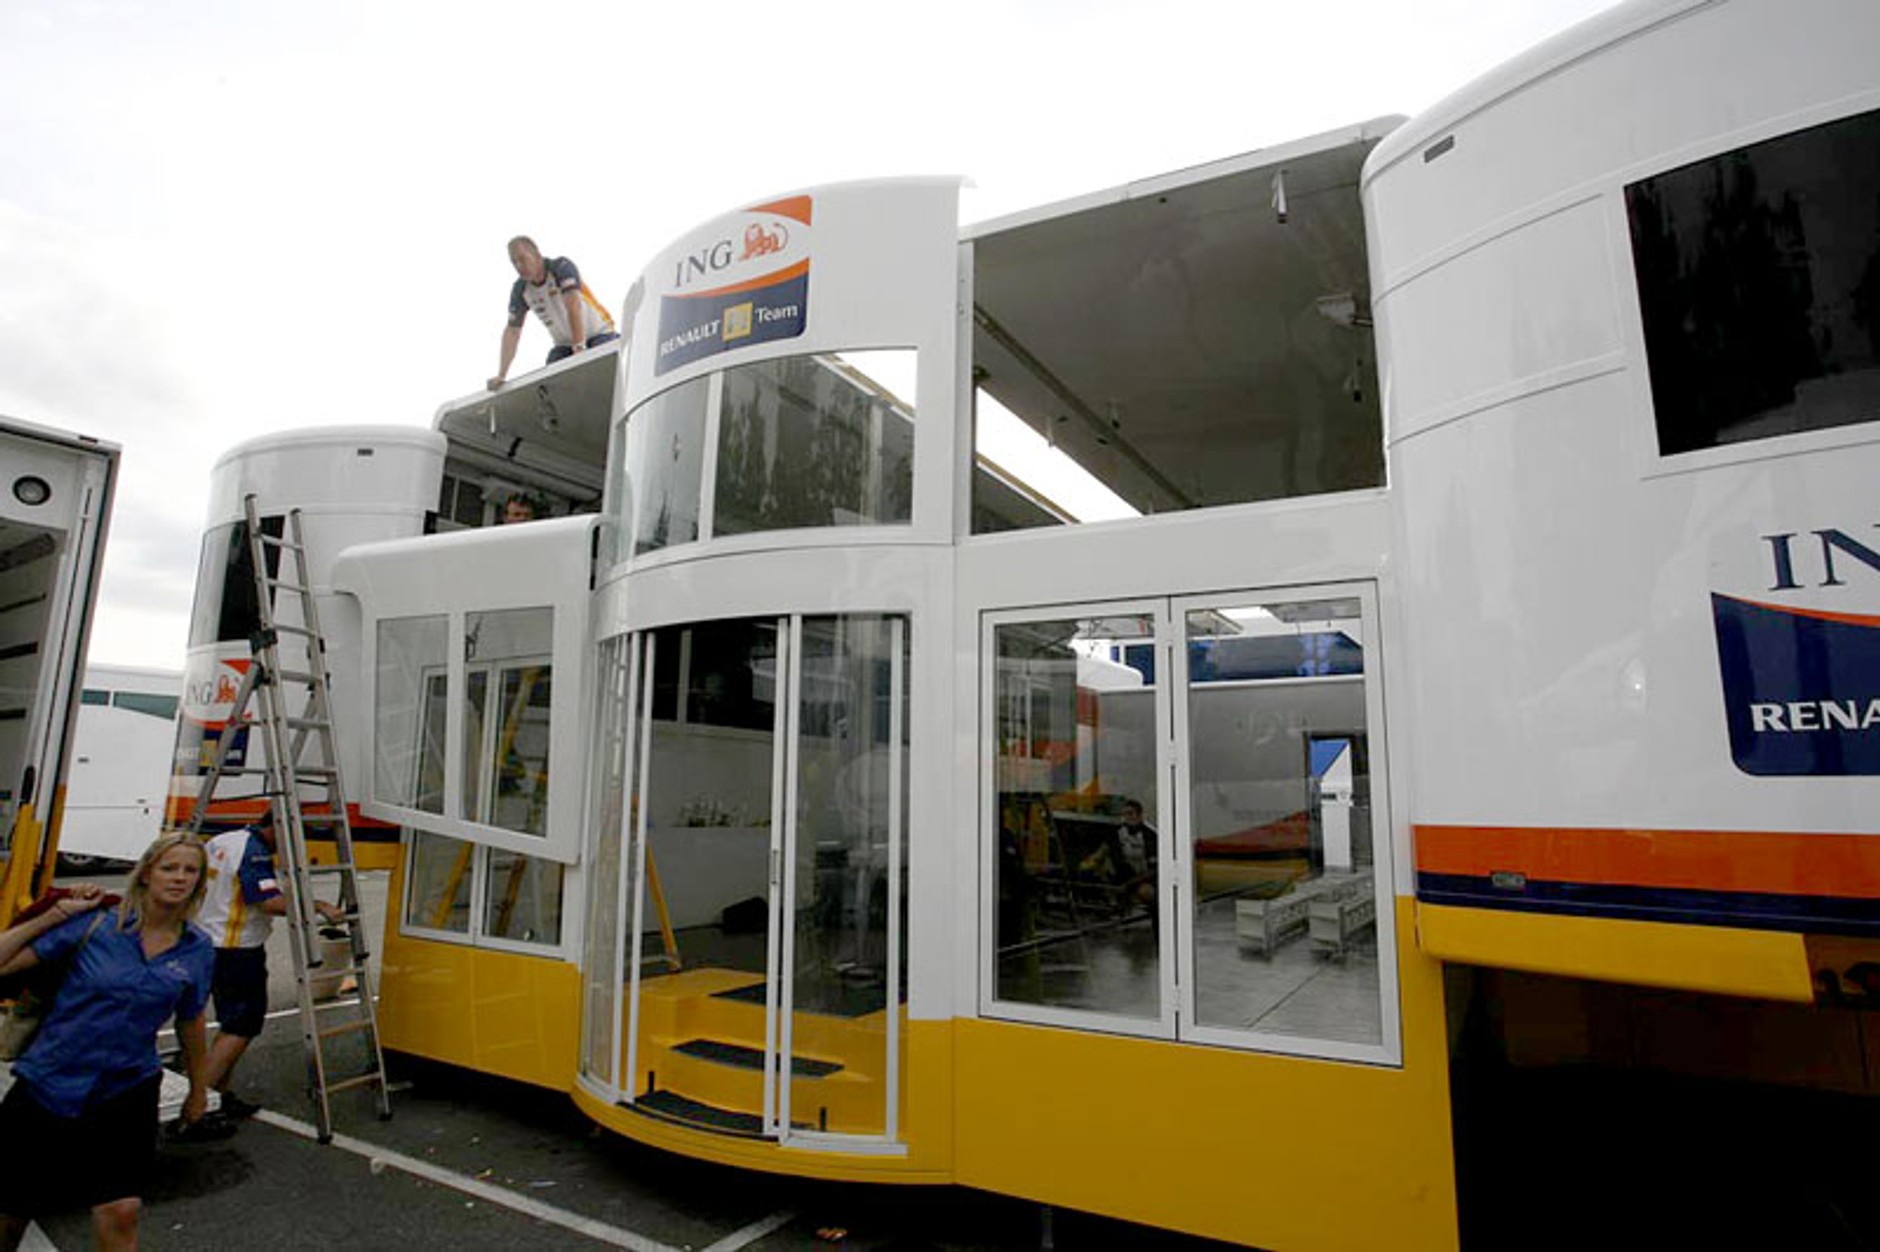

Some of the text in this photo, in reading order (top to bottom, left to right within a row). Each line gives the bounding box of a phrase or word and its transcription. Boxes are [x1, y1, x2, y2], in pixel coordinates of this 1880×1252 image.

[675, 240, 733, 287] ING
[660, 303, 798, 357] RENAULT Team
